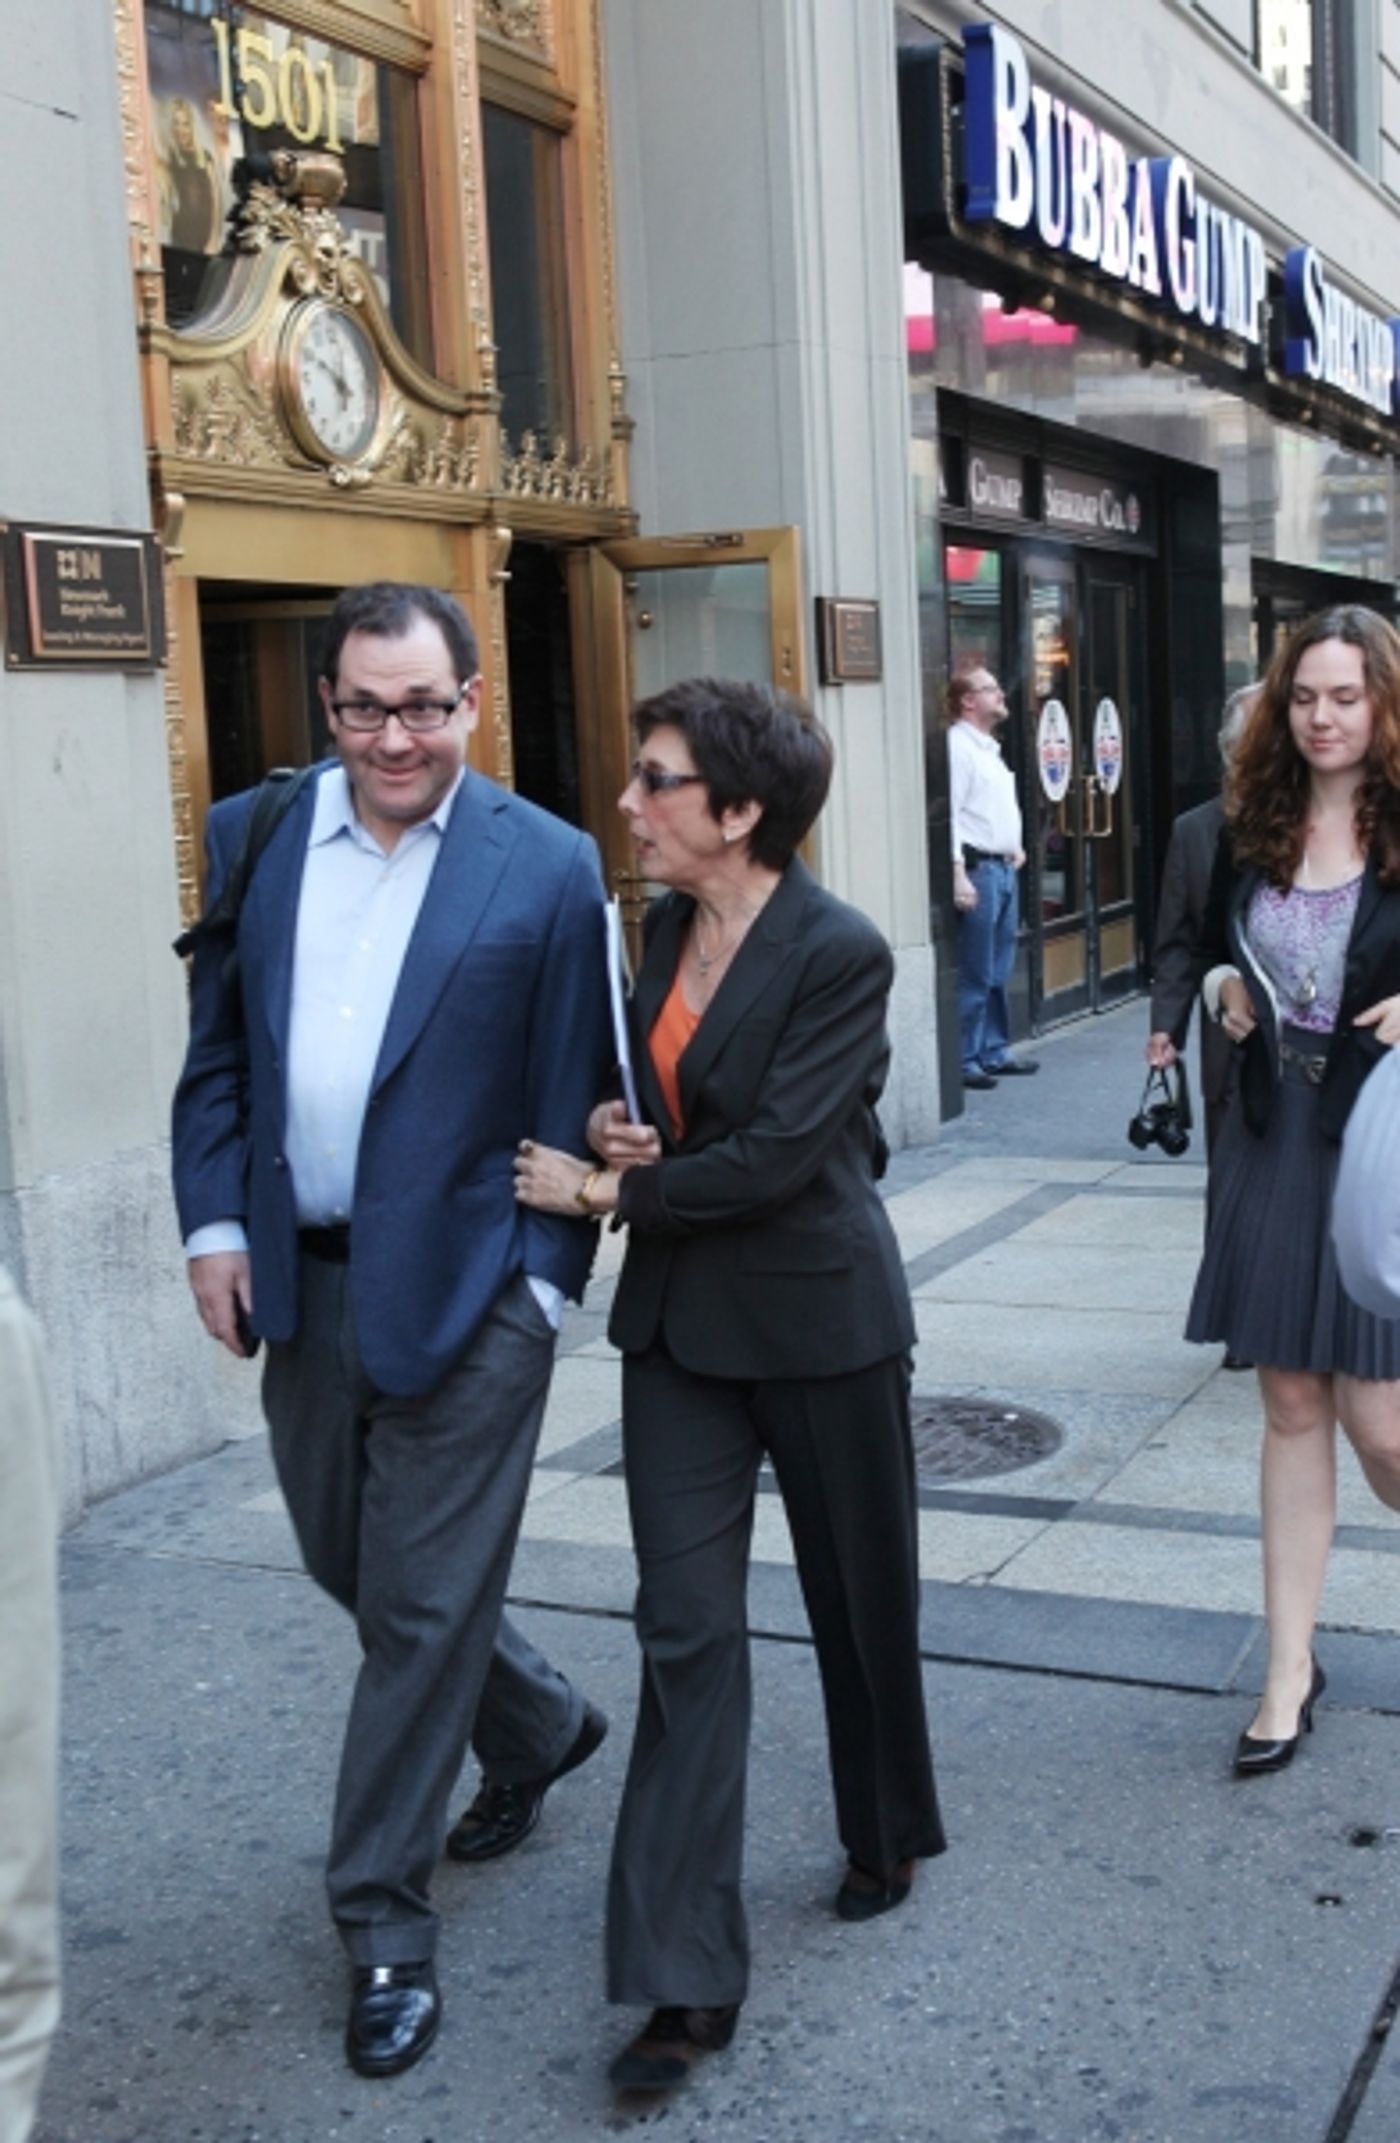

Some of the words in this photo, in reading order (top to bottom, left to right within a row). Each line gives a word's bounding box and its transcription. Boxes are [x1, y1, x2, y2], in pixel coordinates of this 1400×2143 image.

[211, 17, 345, 155] 1501
[989, 23, 1162, 296] BUBBA
[1164, 154, 1266, 344] GUMP
[1303, 245, 1394, 416] SHRIMP
